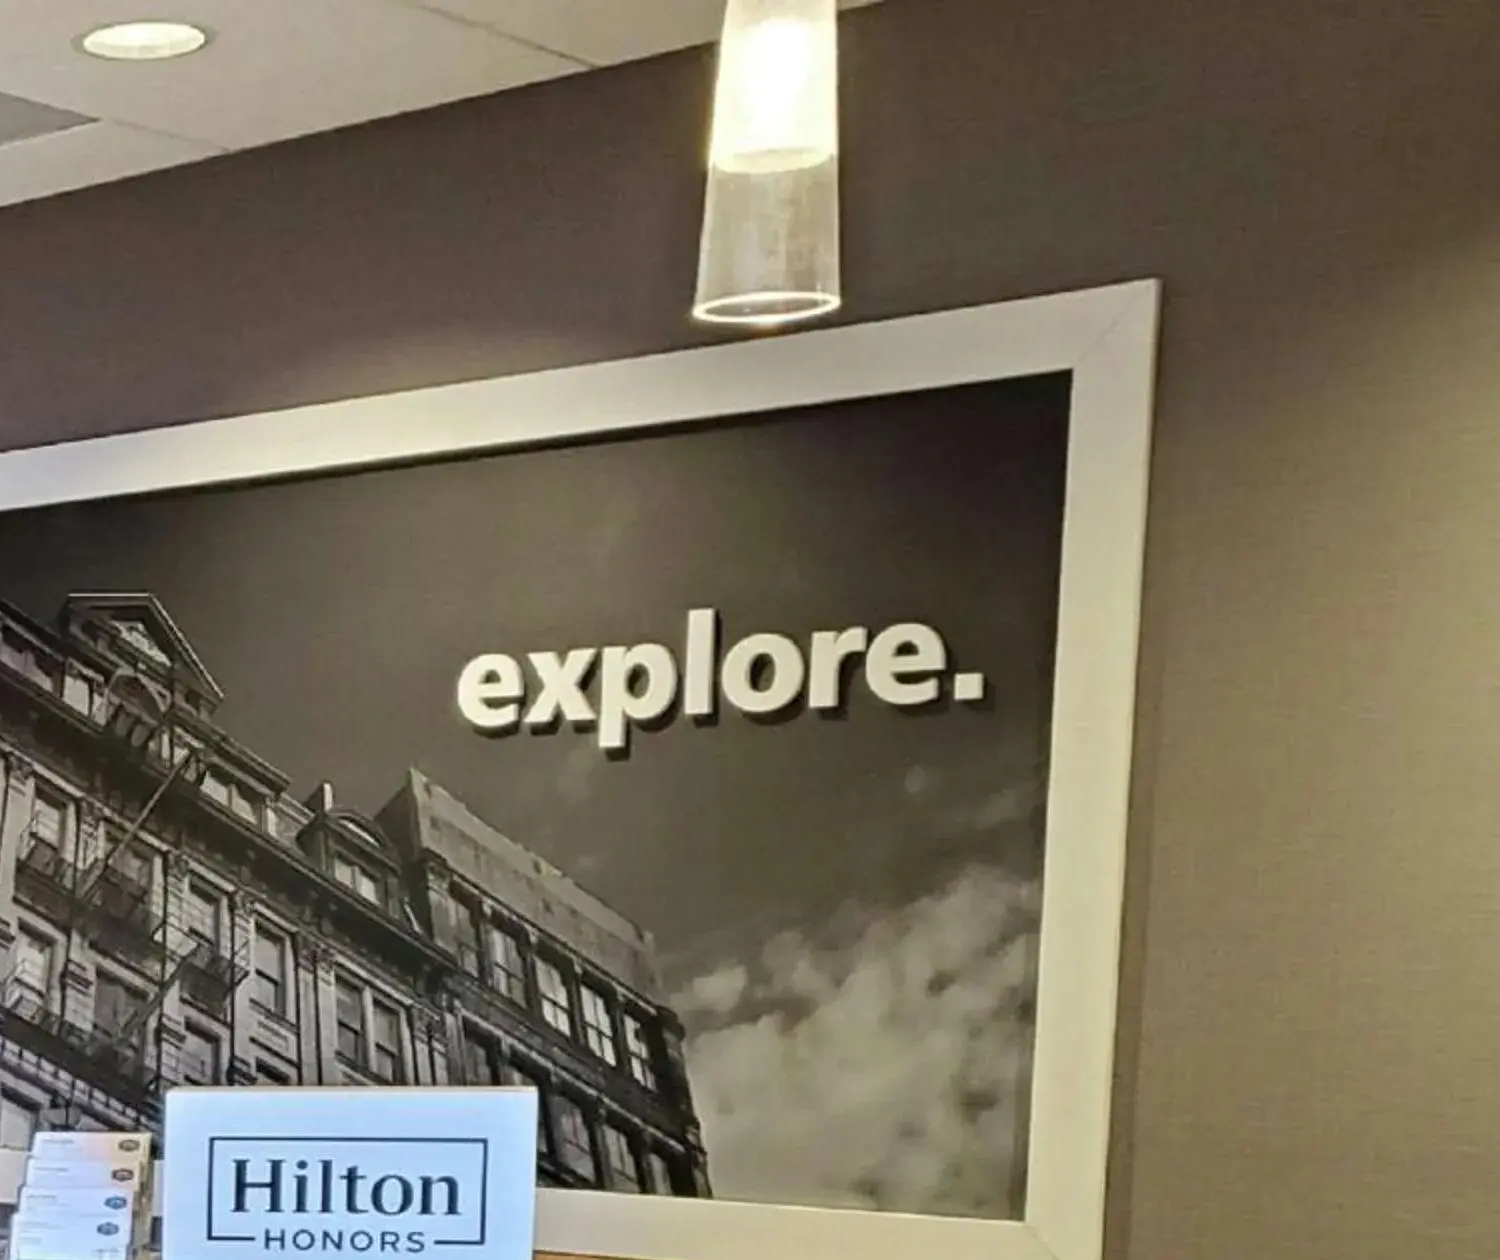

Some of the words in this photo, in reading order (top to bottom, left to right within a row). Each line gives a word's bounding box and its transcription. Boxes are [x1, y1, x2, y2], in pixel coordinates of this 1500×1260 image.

[456, 608, 985, 749] explore.
[230, 1158, 461, 1216] Hilton
[263, 1228, 426, 1253] HONORS
